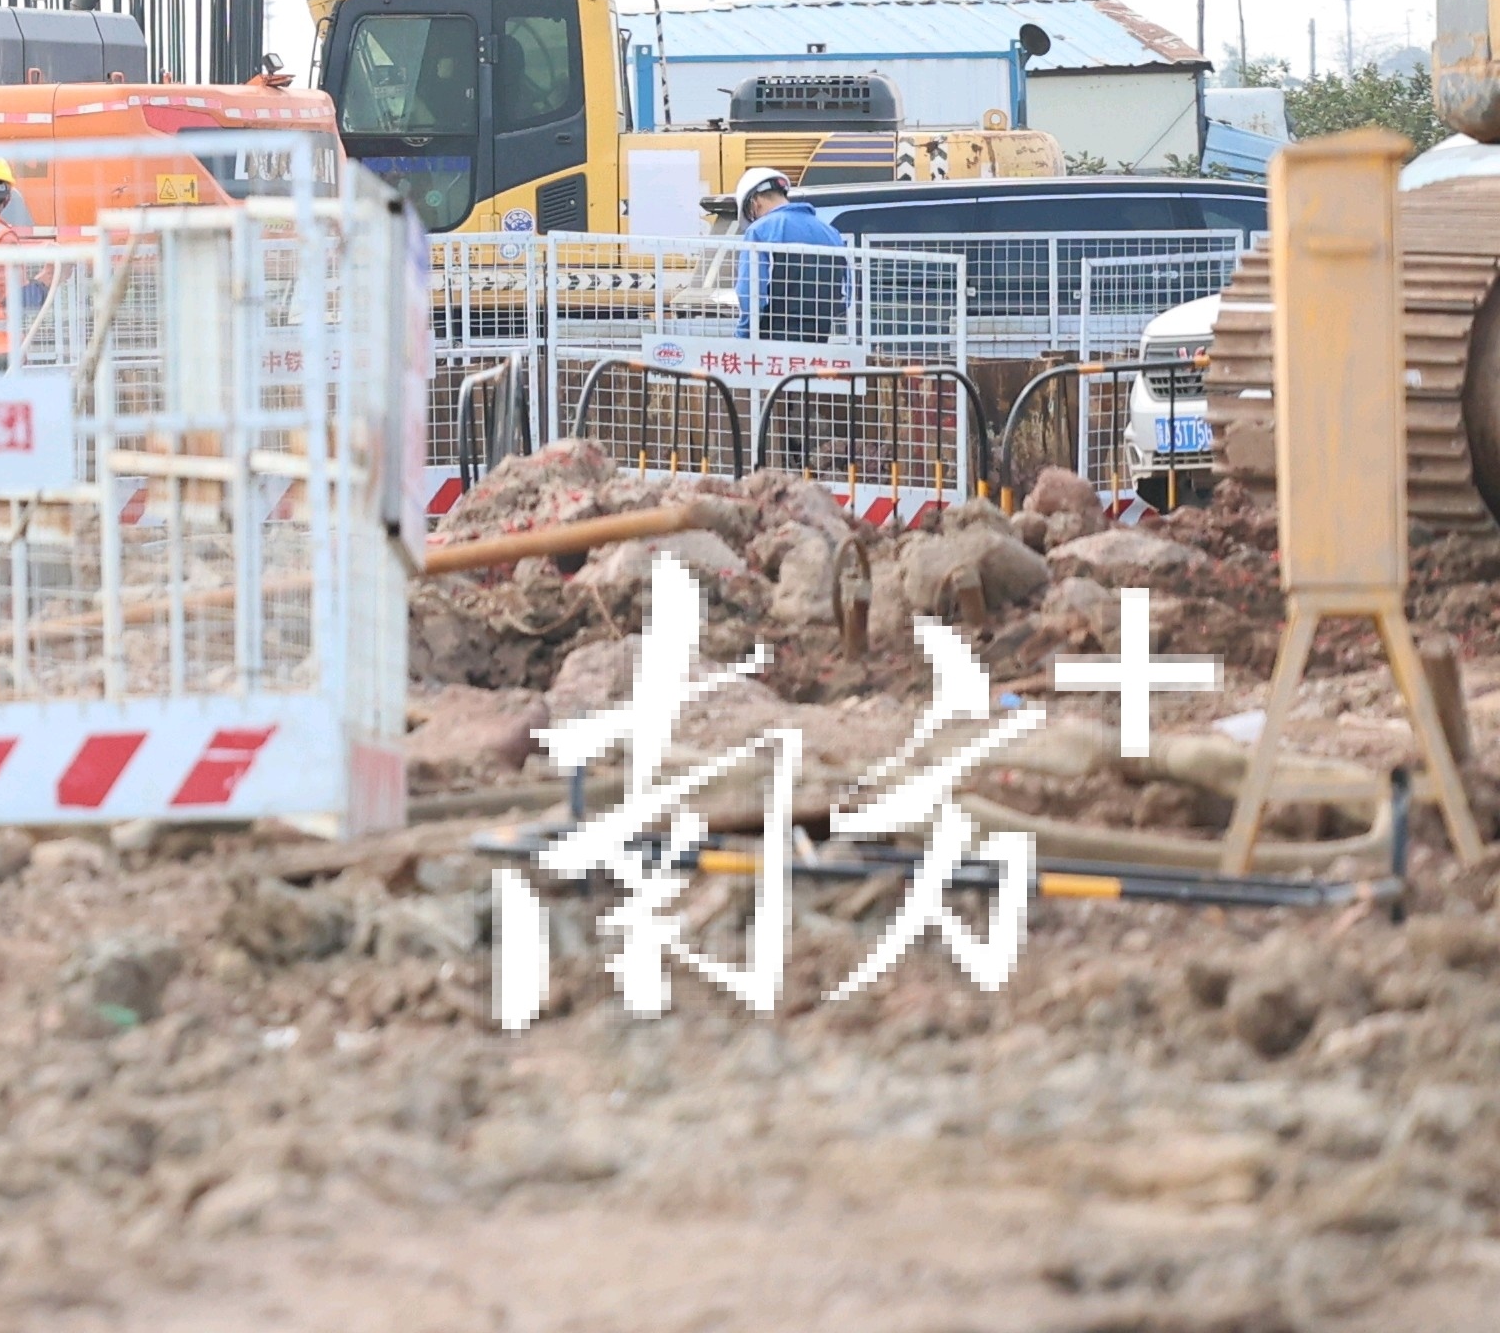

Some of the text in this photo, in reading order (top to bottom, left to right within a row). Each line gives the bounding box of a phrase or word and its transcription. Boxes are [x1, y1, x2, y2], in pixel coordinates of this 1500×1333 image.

[700, 350, 852, 381] 中铁十五局集团
